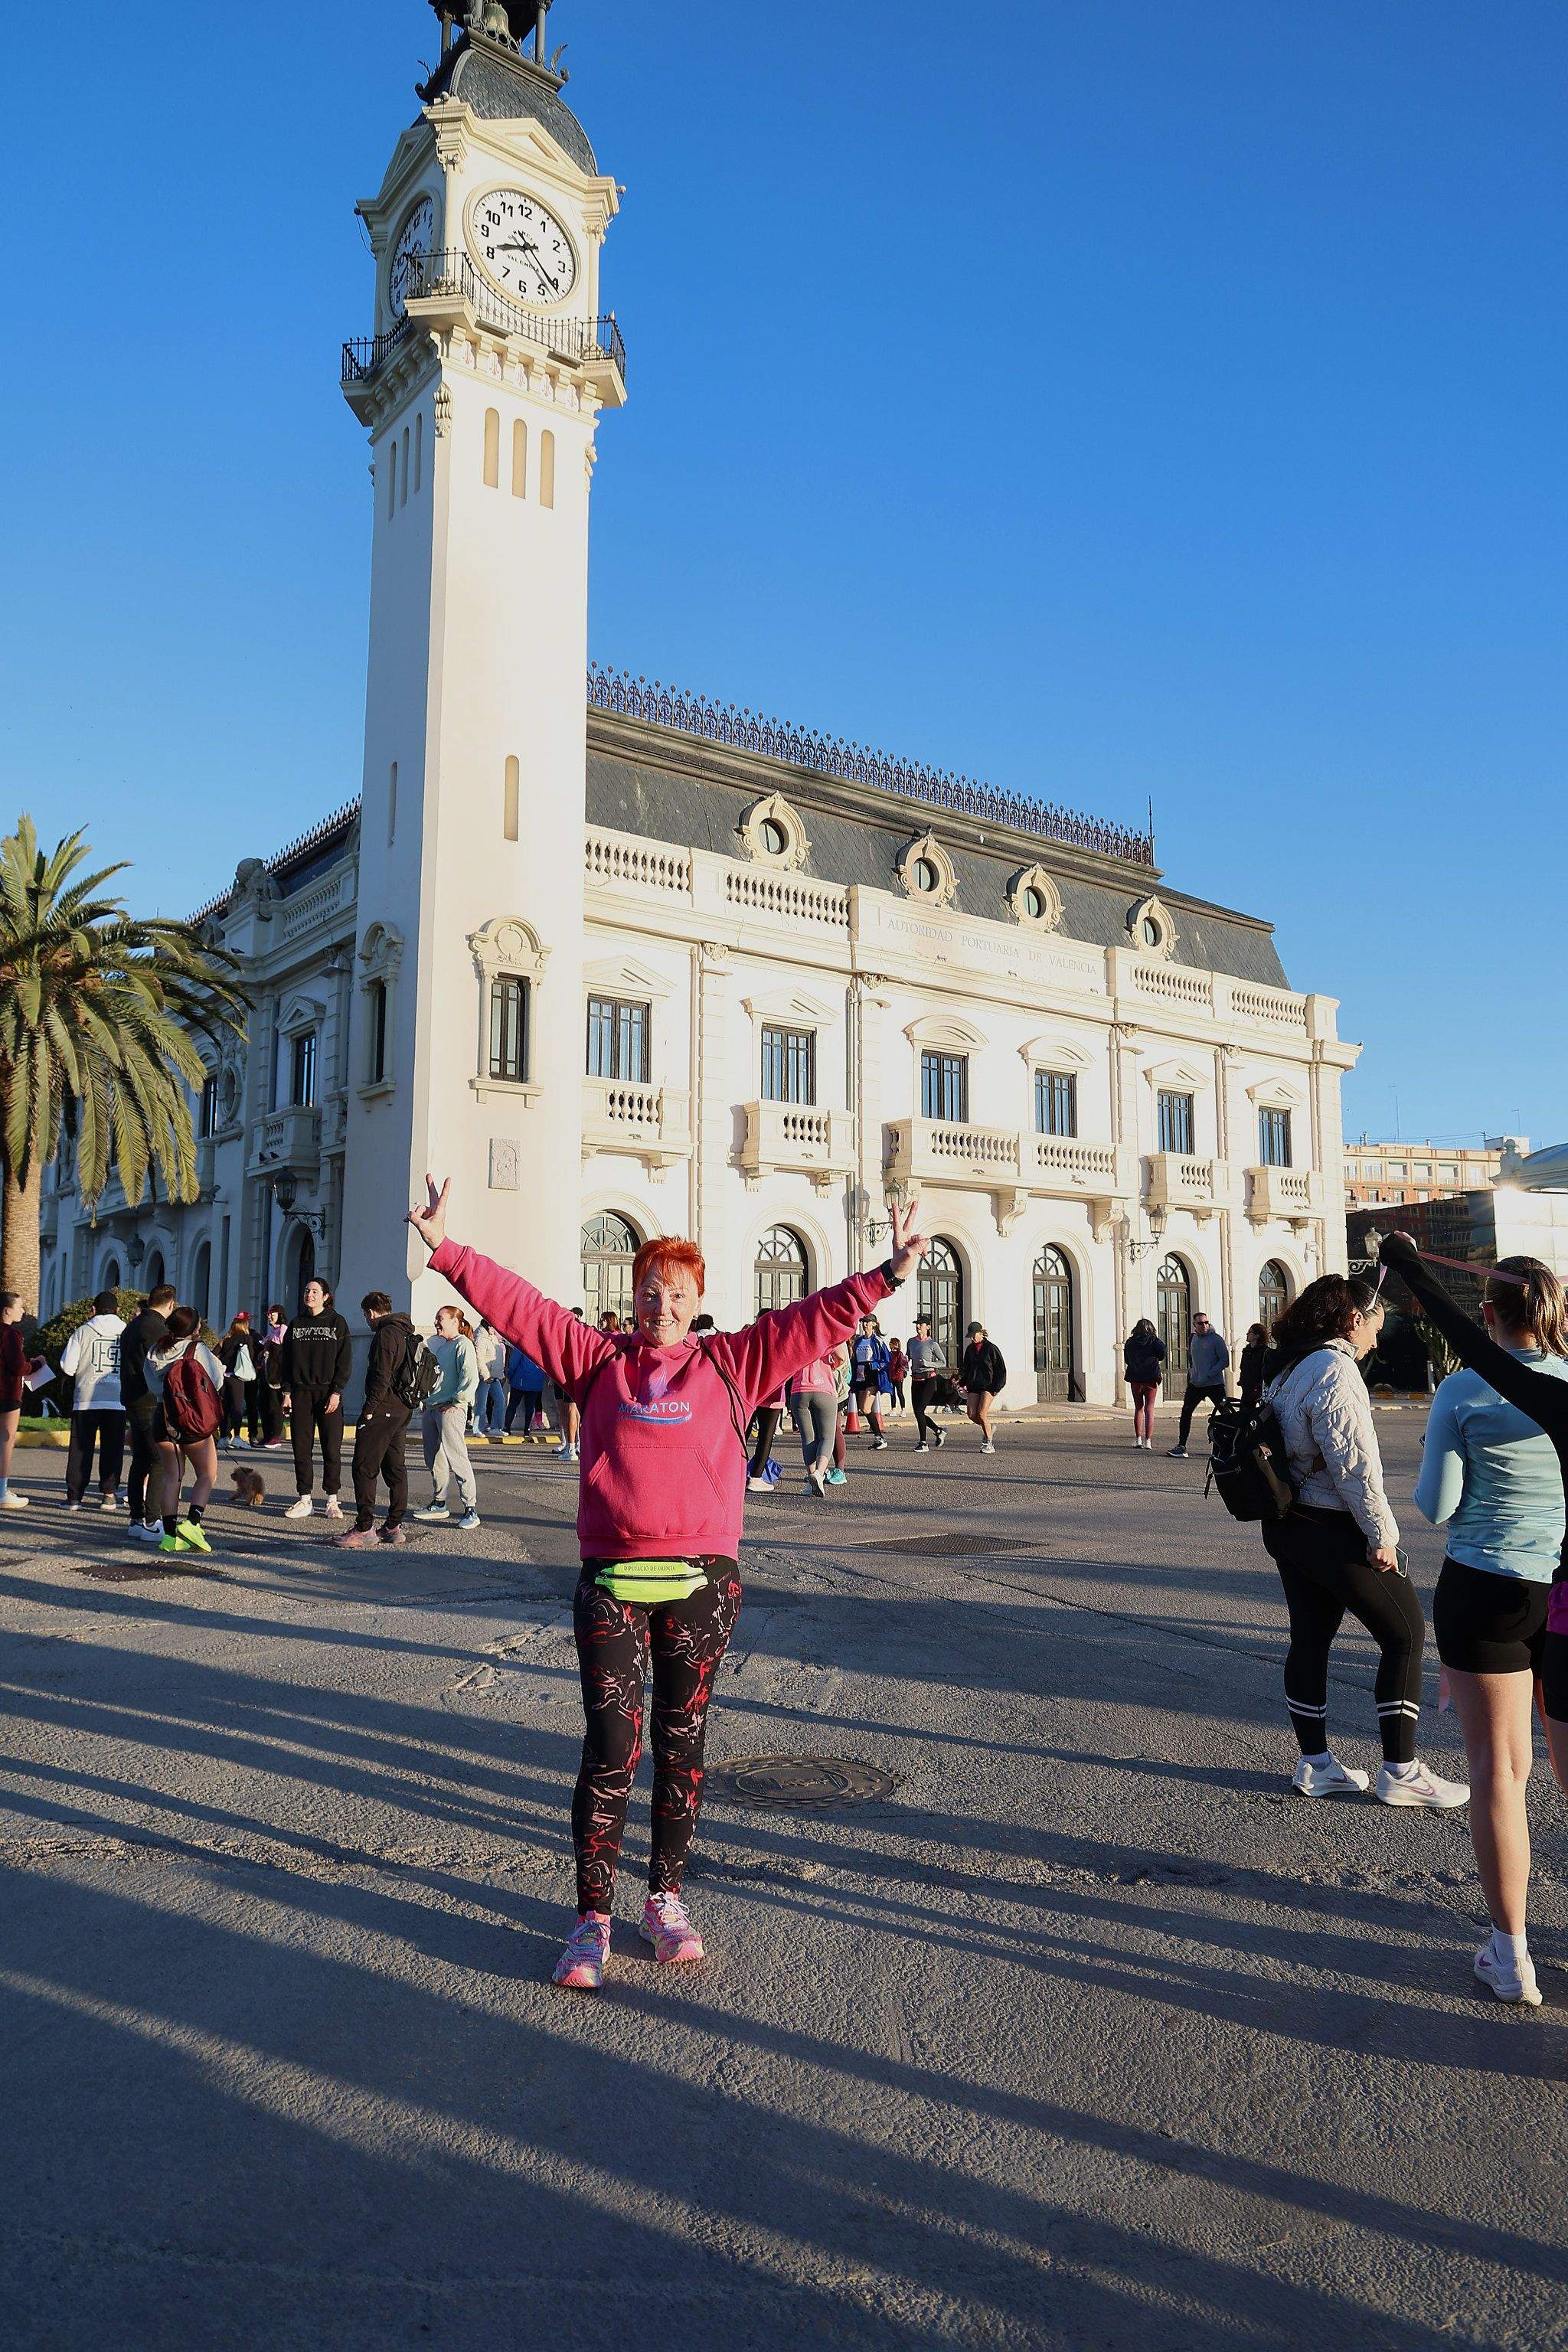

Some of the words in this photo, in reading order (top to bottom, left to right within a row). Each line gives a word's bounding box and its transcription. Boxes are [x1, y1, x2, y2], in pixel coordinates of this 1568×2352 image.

[500, 201, 514, 217] 11
[518, 204, 532, 220] 12
[485, 210, 501, 226] 10
[481, 224, 489, 237] 9
[540, 220, 546, 233] 1
[552, 240, 560, 253] 2
[486, 247, 495, 260] 8
[501, 266, 510, 278] 7
[557, 261, 565, 273] 3
[518, 280, 527, 293] 6
[537, 283, 546, 296] 5
[887, 919, 952, 942] AUTORIDAD
[962, 935, 1020, 959] PORTUARIA
[1028, 950, 1042, 962] DE
[1048, 955, 1096, 975] VALENCIA
[618, 1401, 691, 1414] MARATON
